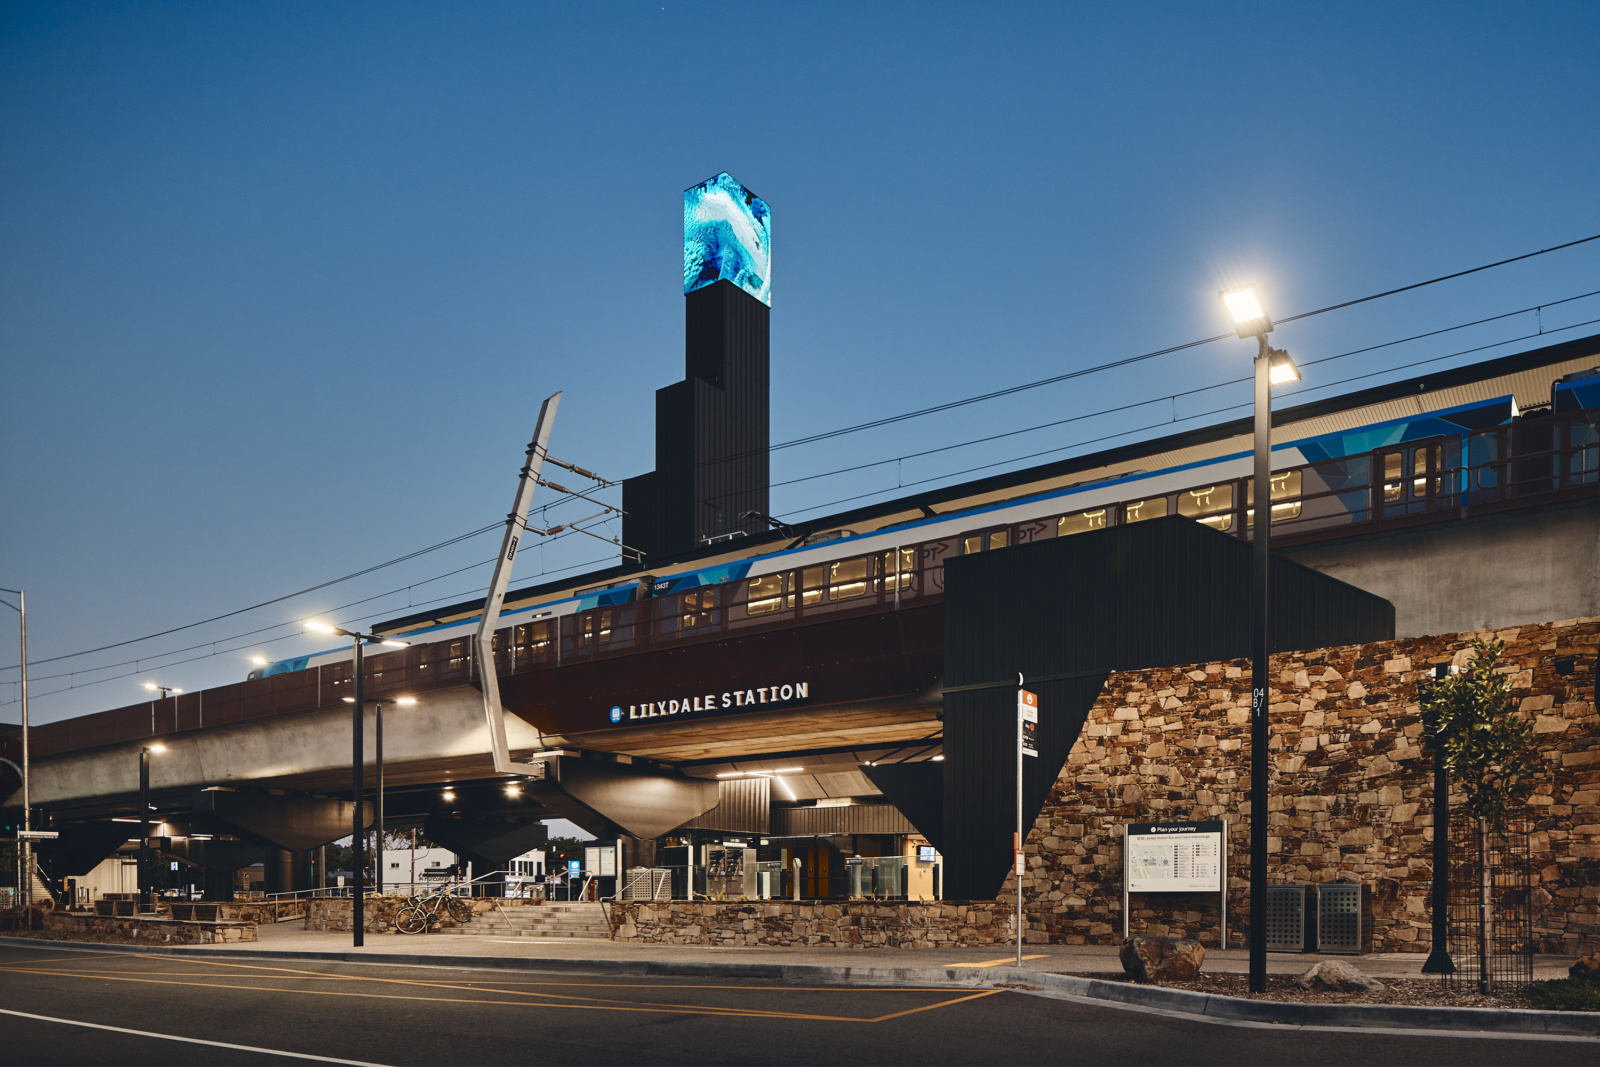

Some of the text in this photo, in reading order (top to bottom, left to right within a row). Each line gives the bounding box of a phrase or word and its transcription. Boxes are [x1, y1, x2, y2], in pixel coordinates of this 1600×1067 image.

[629, 682, 809, 719] LILYDALE STATION
[1253, 688, 1264, 697] 04
